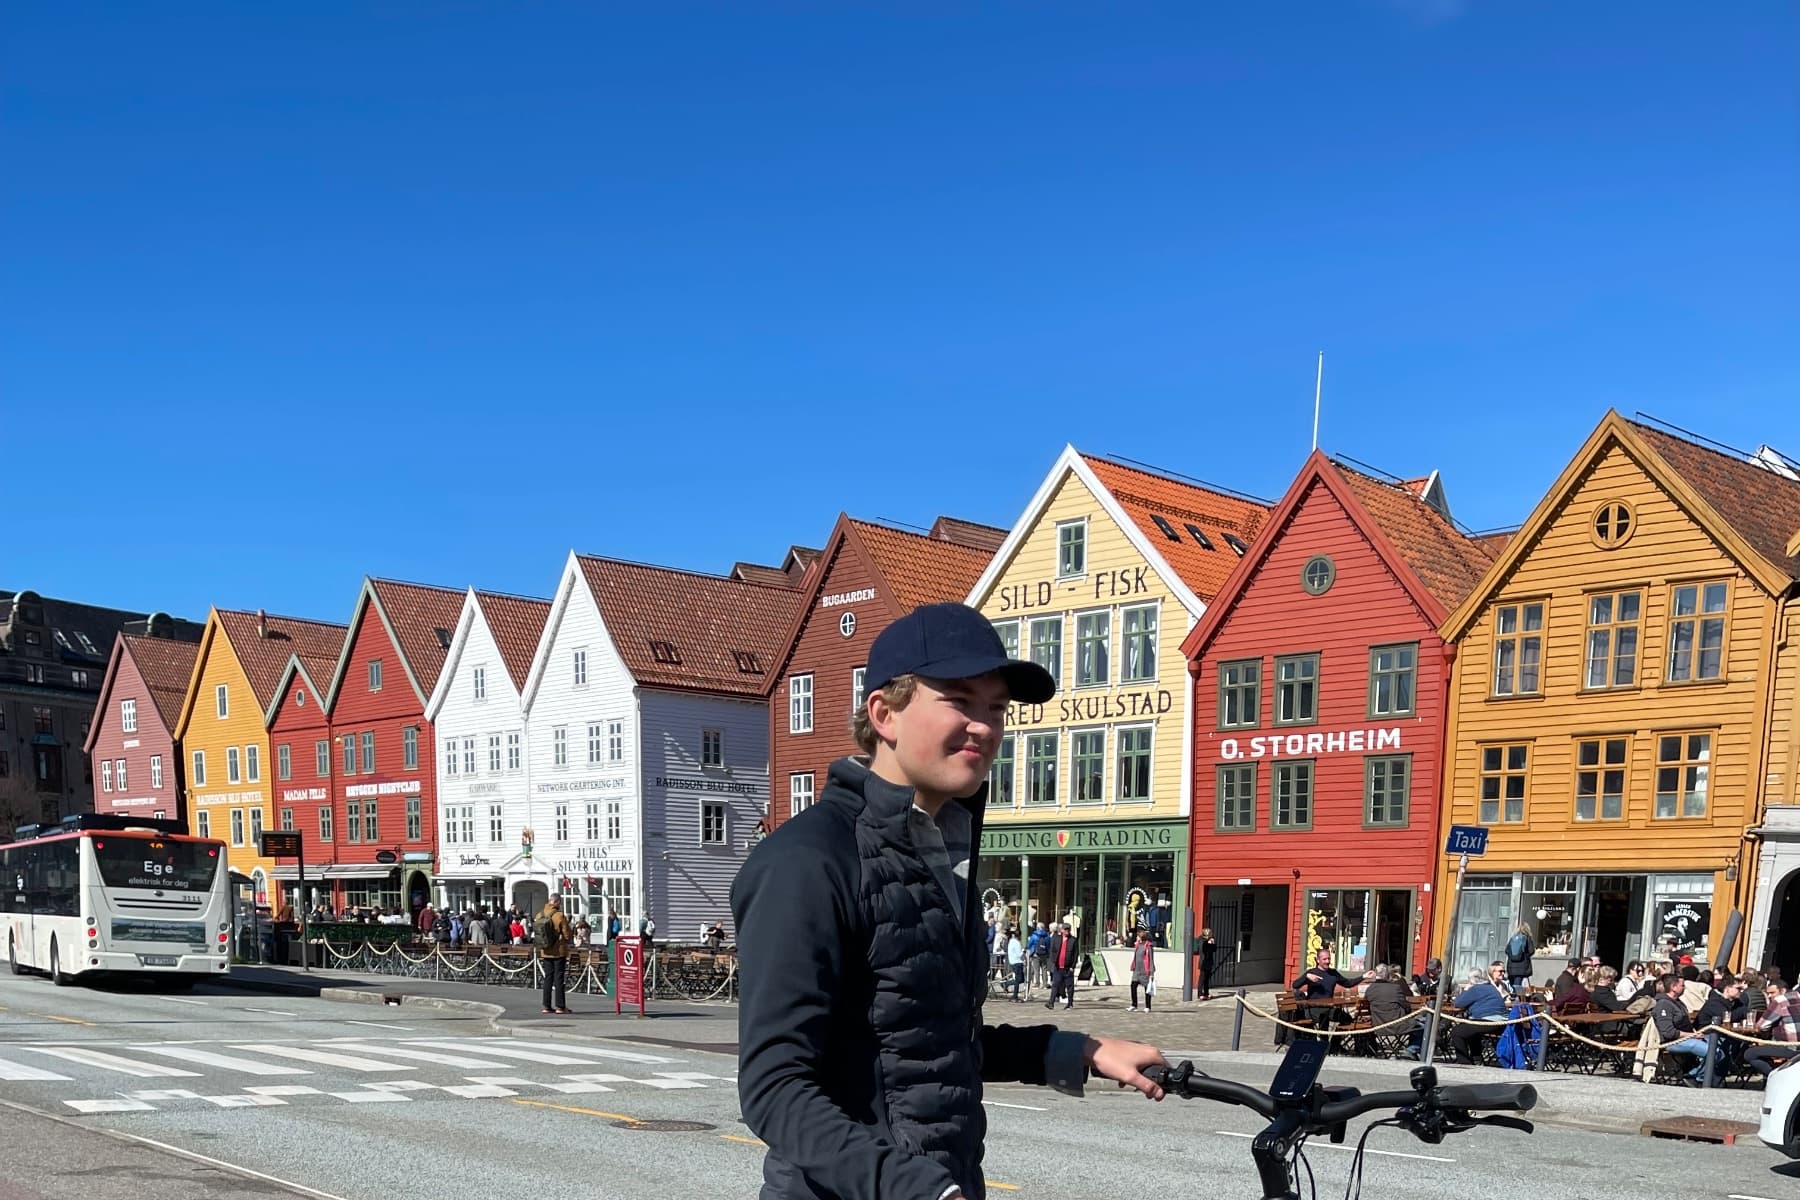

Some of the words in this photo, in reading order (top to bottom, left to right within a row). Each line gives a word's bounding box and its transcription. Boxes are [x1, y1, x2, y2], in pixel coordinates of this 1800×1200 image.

[822, 587, 875, 608] BUGAARDEN
[1000, 581, 1052, 612] SILD
[1095, 566, 1149, 599] FISK
[1060, 690, 1172, 722] SKULSTAD
[1220, 738, 1245, 760] O.
[1250, 727, 1401, 758] STORHEIM
[537, 782, 569, 793] NETWORK
[655, 777, 703, 790] RADISSON
[707, 781, 724, 791] BLU
[727, 783, 758, 793] HOTEL
[1074, 828, 1172, 847] TRADING
[1455, 831, 1483, 849] Taxi
[558, 860, 589, 872] SILVER
[593, 859, 633, 872] GALLERY
